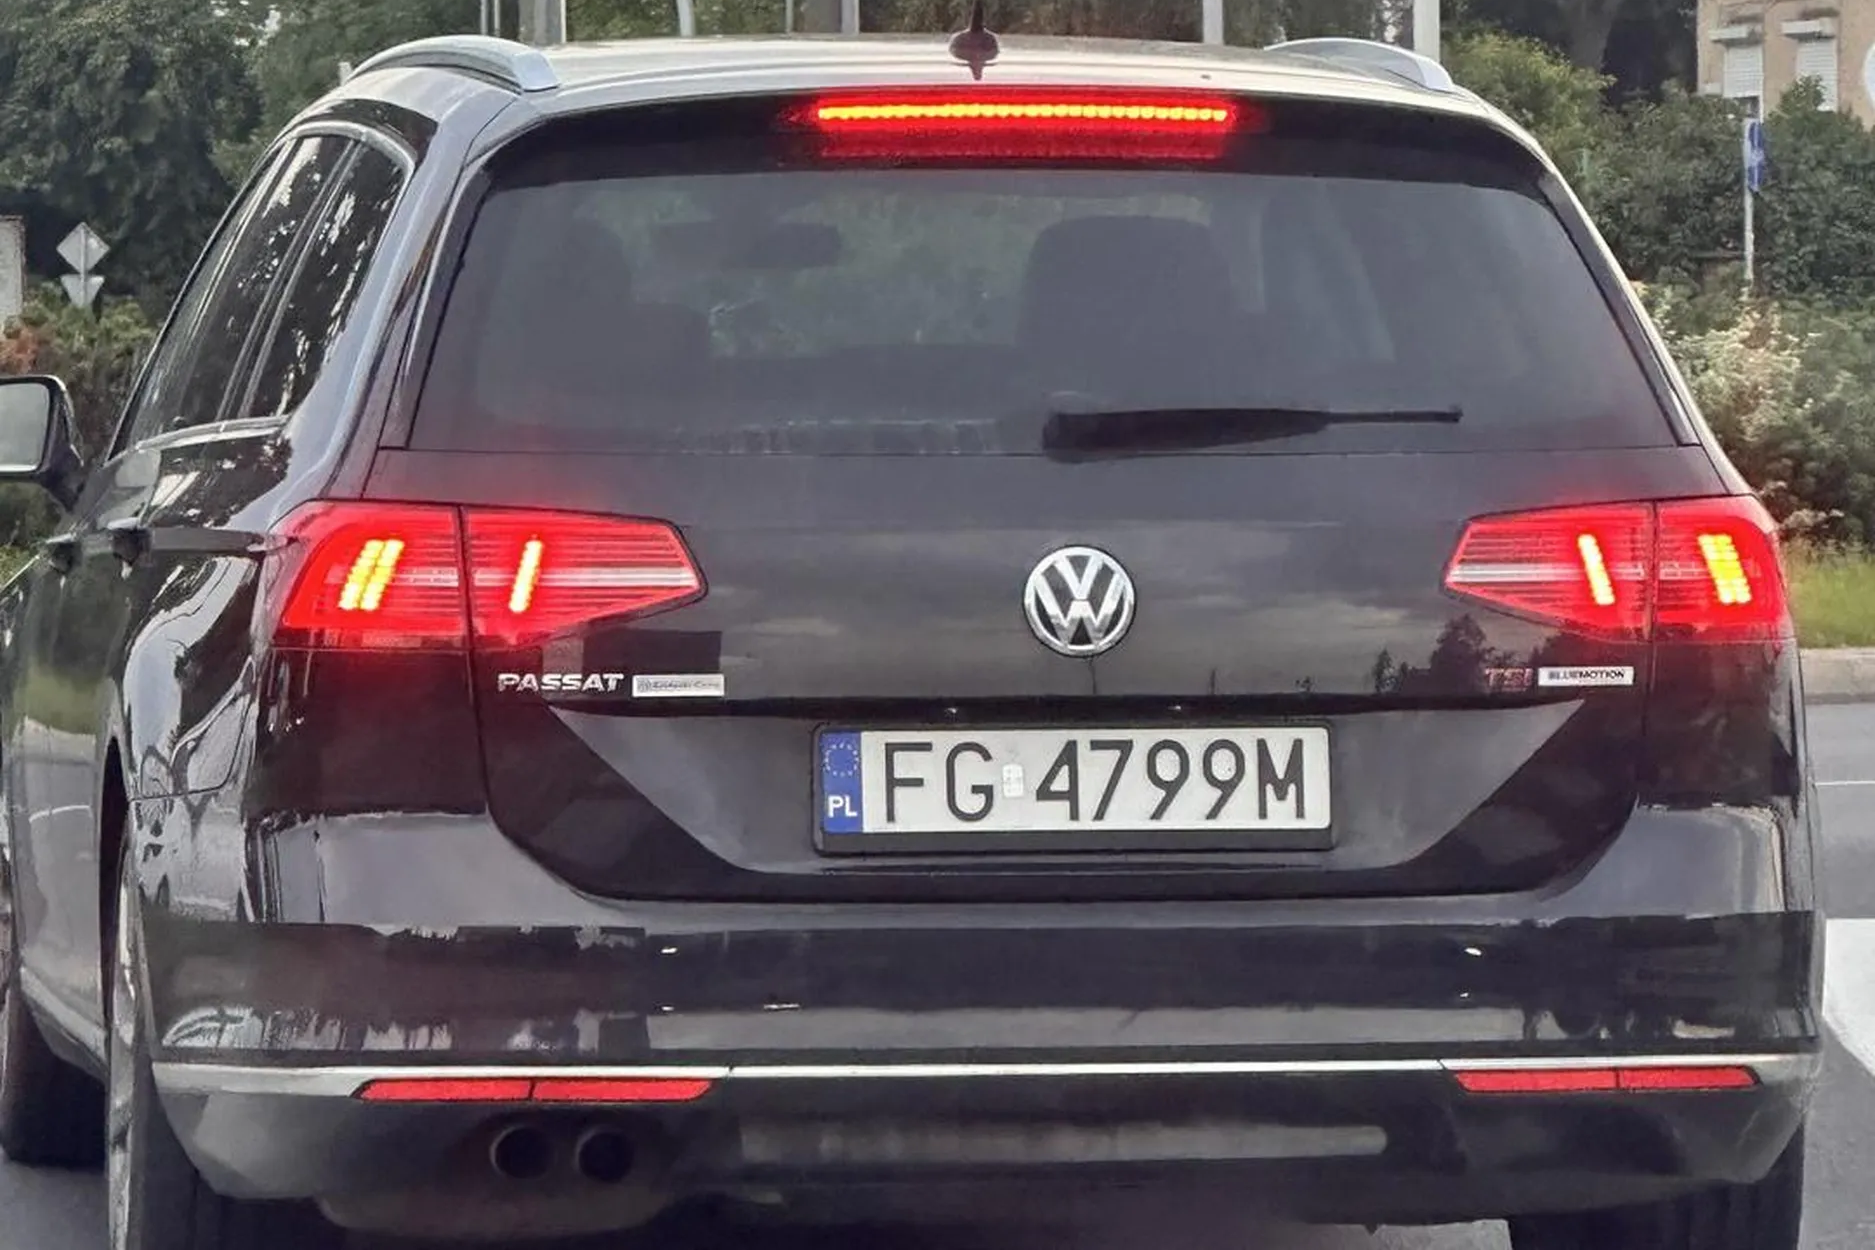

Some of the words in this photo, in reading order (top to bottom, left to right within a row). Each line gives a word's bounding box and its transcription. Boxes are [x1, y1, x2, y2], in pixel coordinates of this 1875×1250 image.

[497, 672, 625, 692] PASSAT
[1547, 668, 1625, 680] BLUEMOTION
[884, 741, 994, 823] FG
[1036, 738, 1305, 821] 4799M
[827, 795, 858, 818] PL
